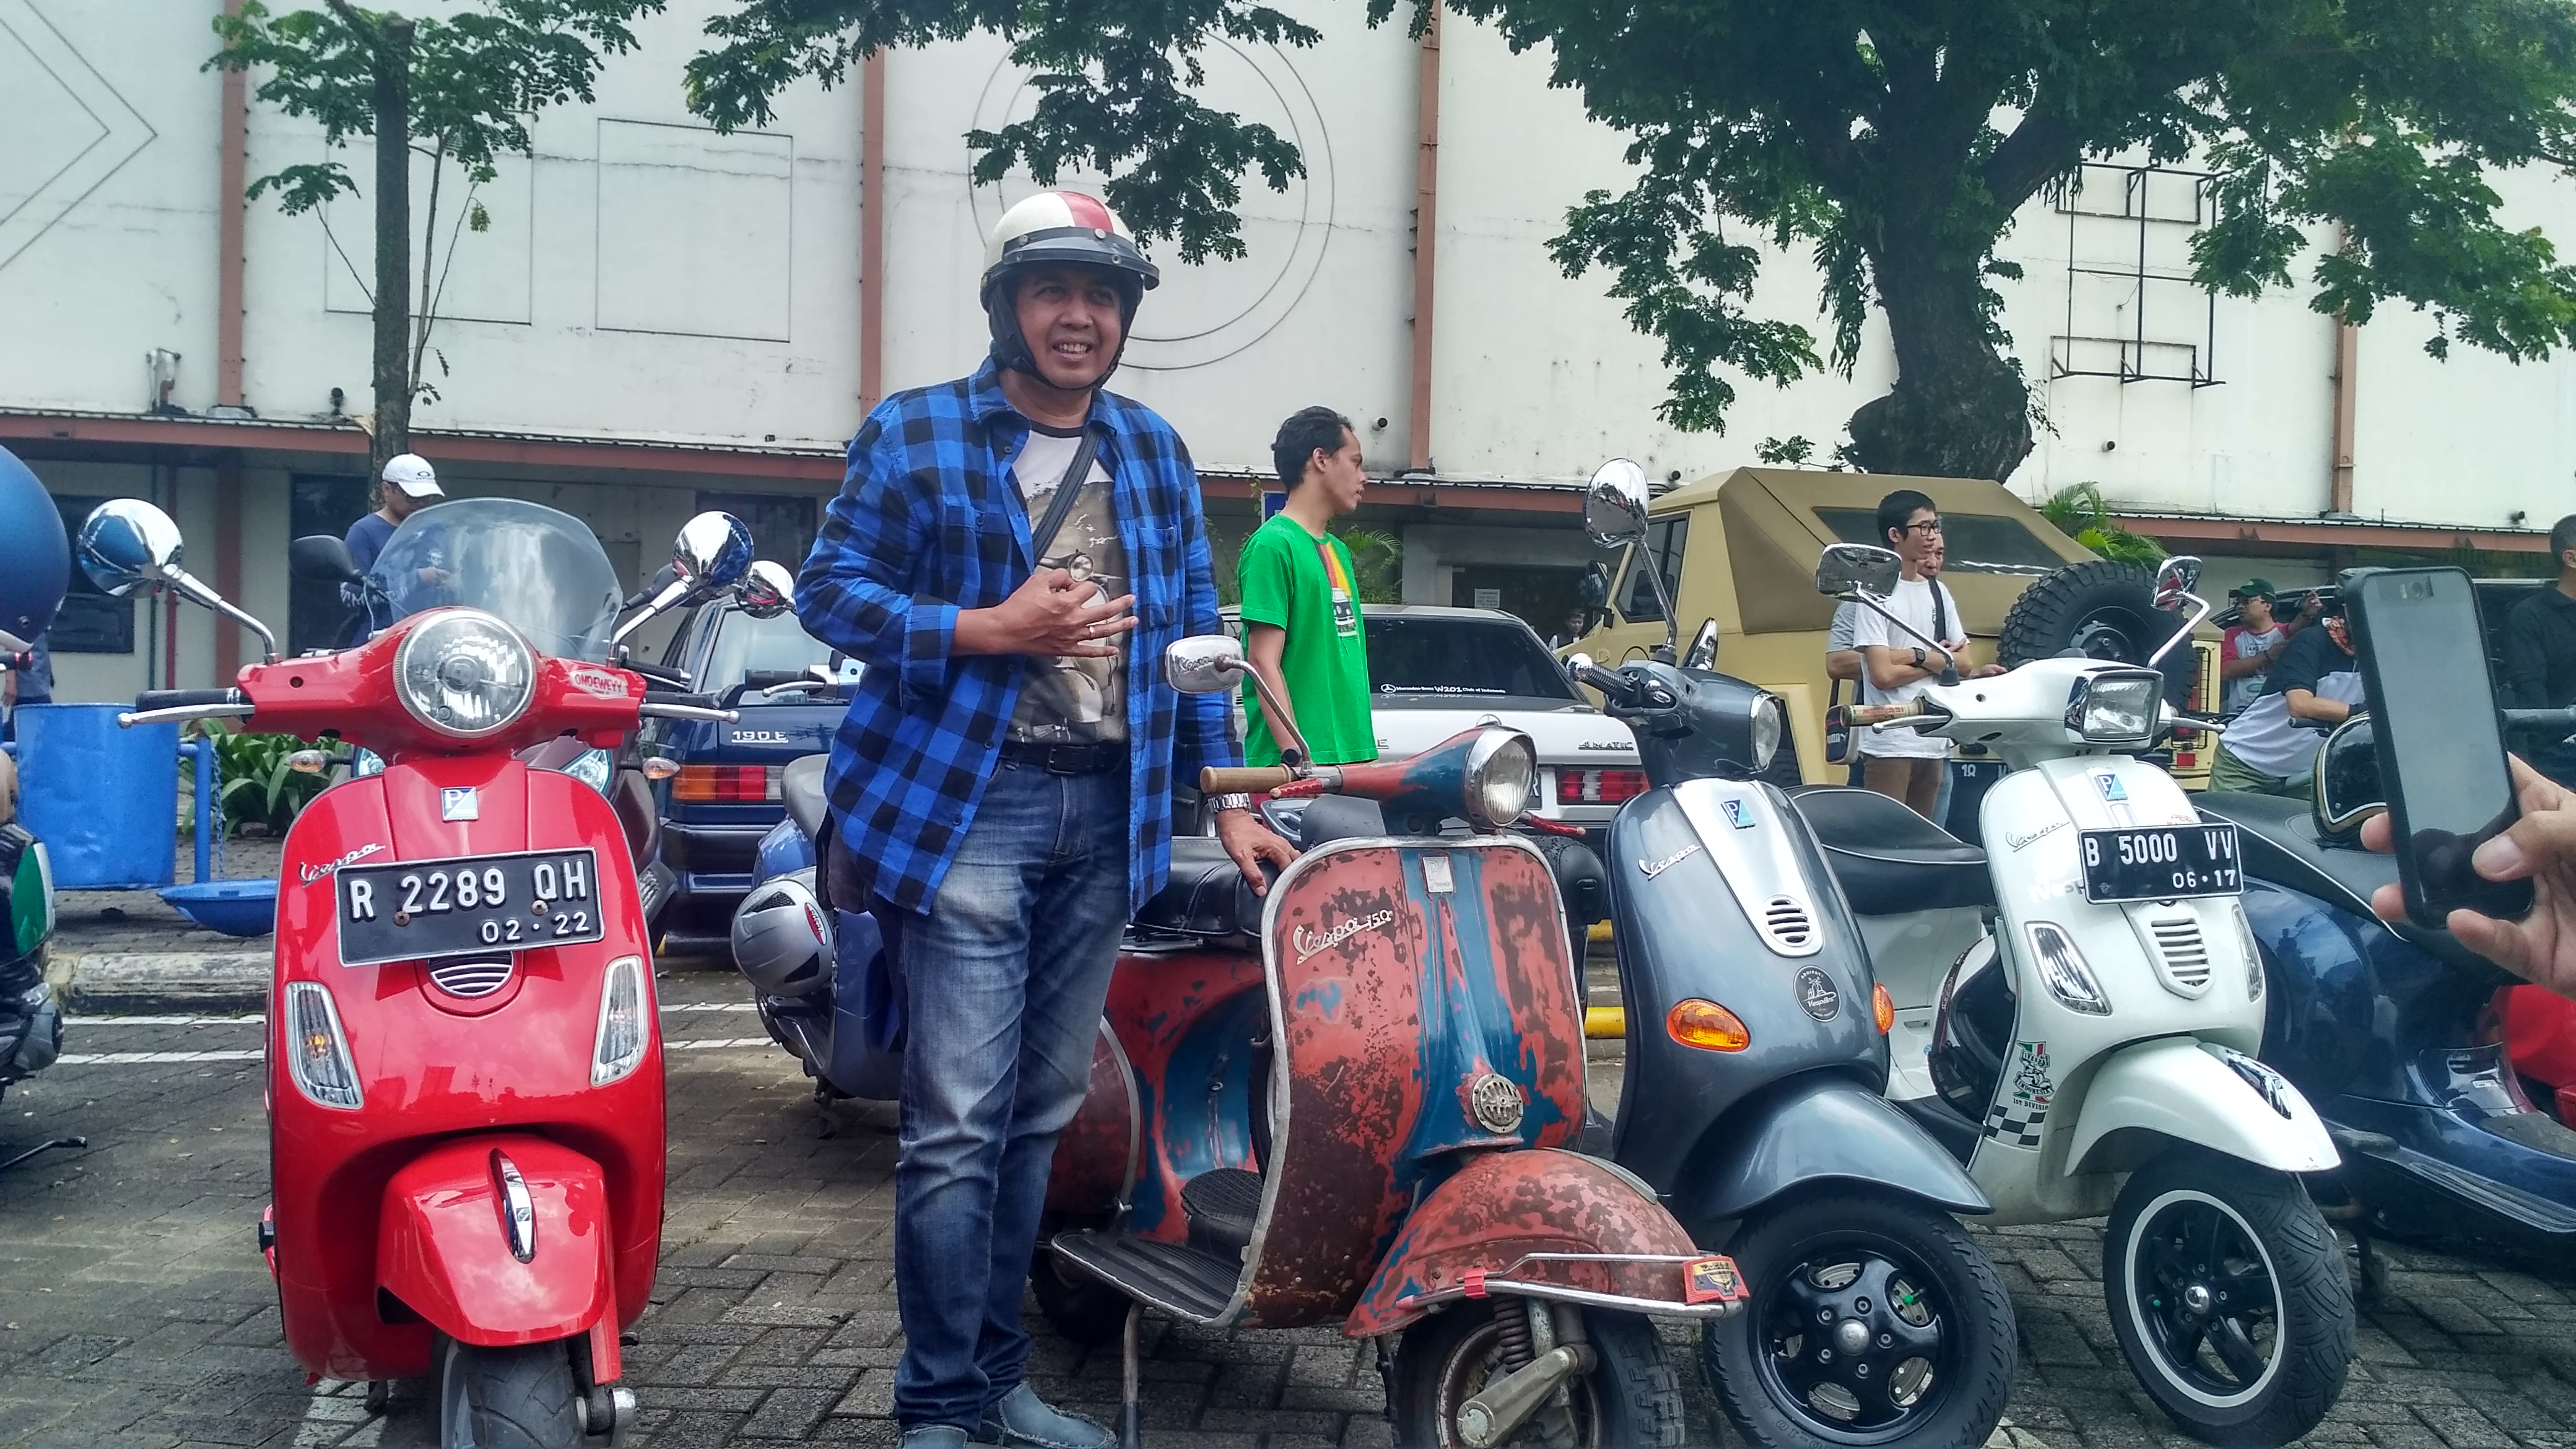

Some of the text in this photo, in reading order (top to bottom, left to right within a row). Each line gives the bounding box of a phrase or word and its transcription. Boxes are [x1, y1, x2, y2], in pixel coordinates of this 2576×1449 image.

[299, 842, 386, 888] Vespa
[1638, 845, 1702, 881] Vespa
[2084, 831, 2232, 867] B 5000 VV
[349, 860, 588, 919] R 2289 QH
[1293, 917, 1364, 965] Vespa
[2018, 1081, 2051, 1095] INDONESIA
